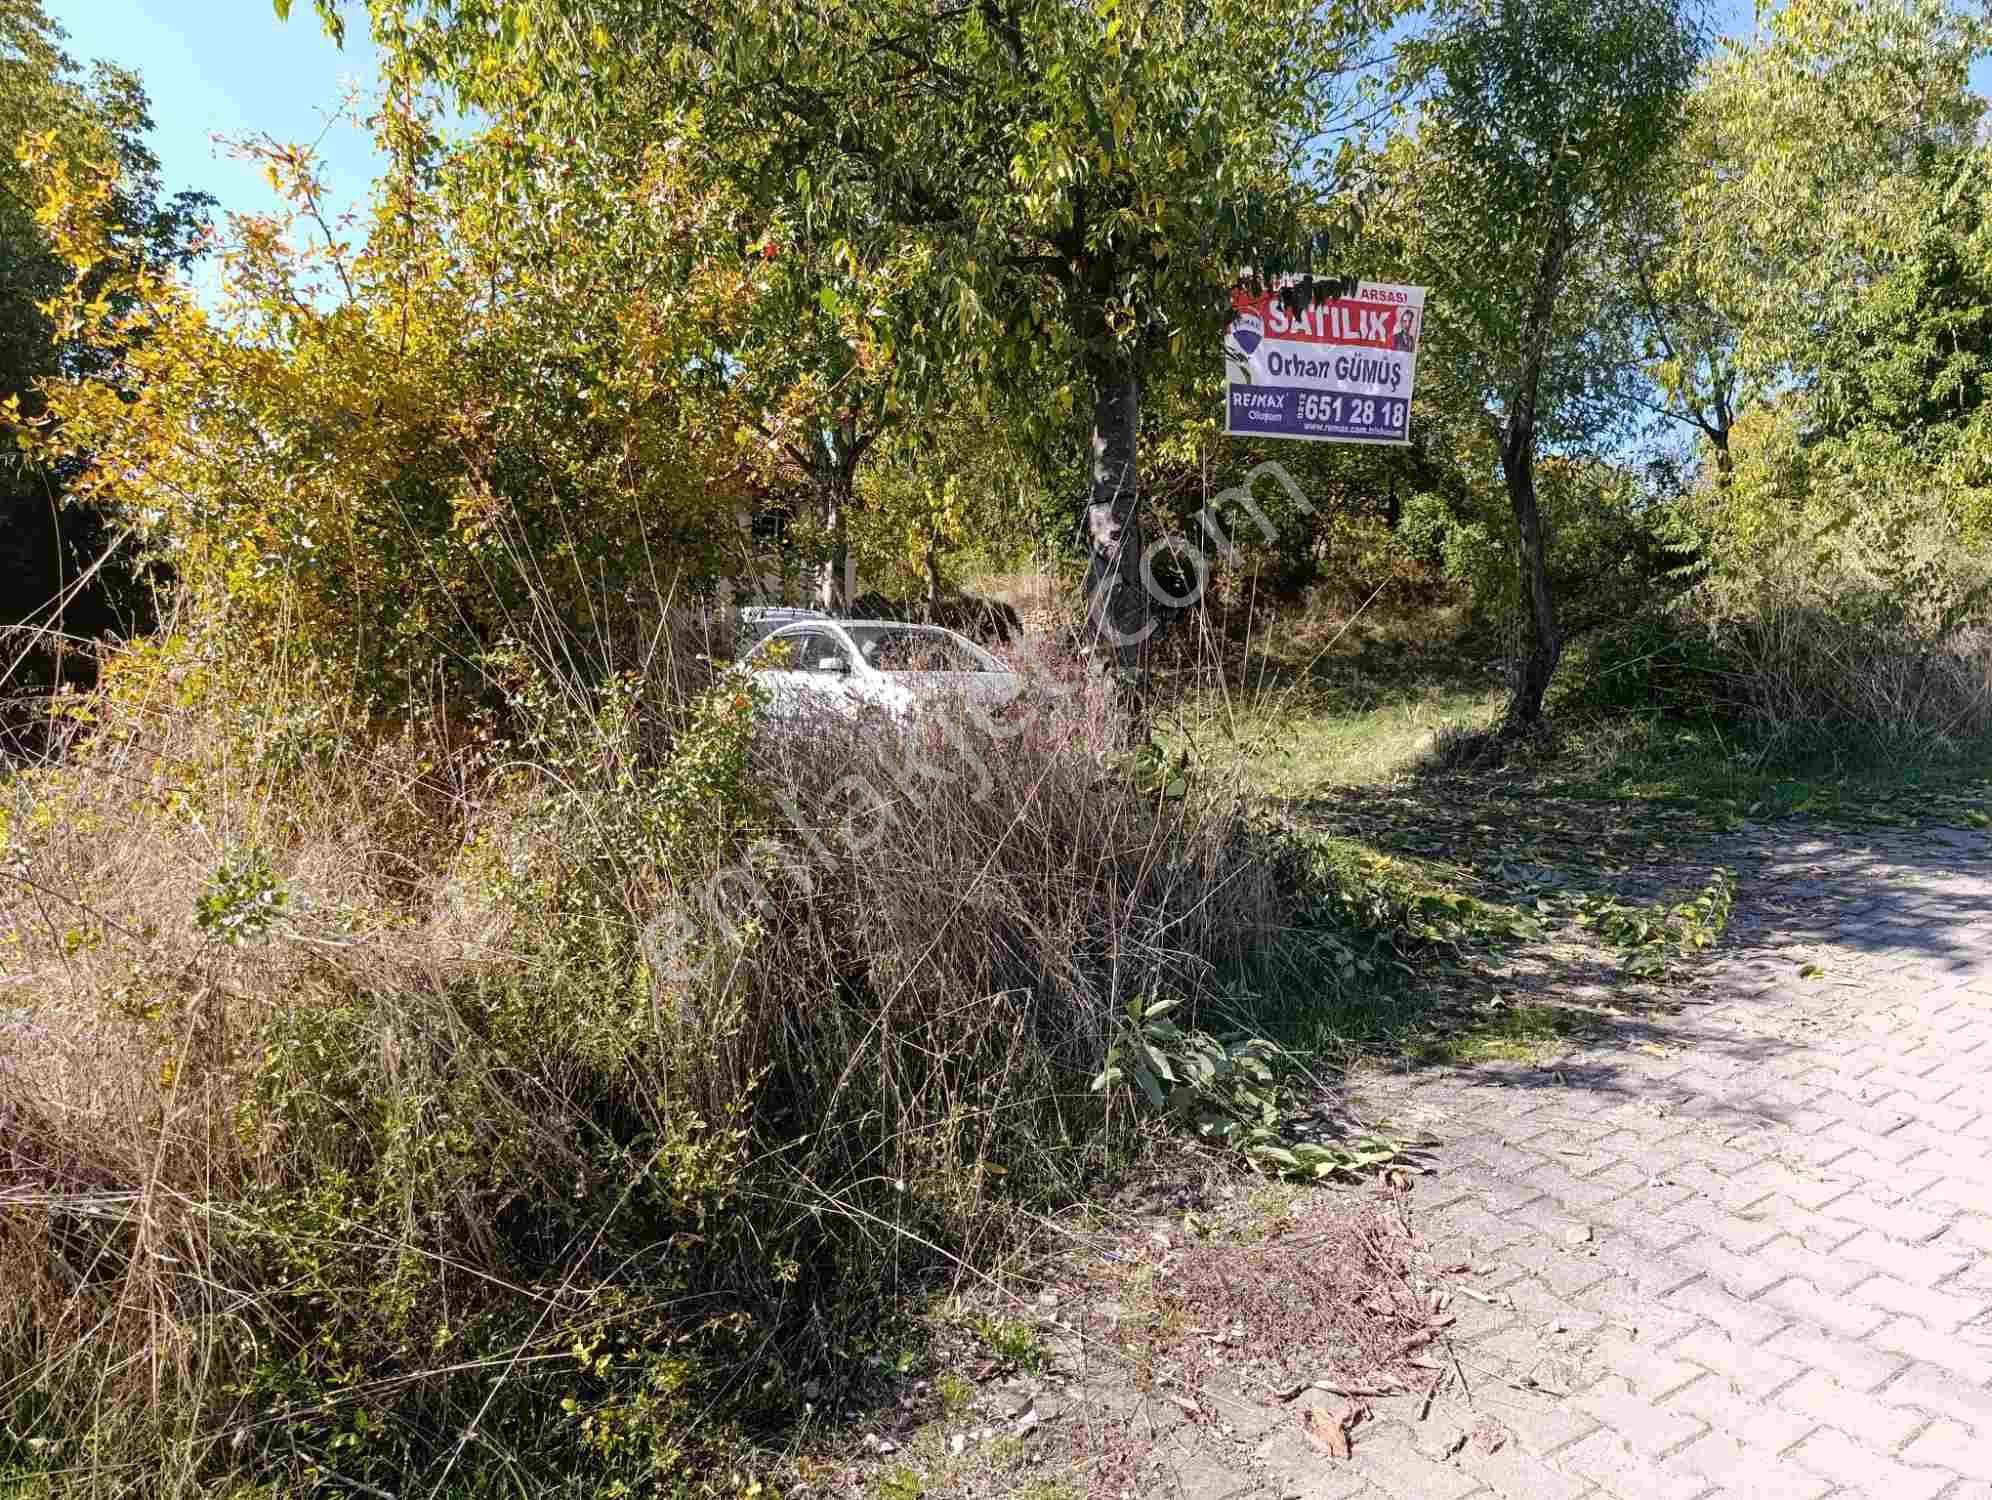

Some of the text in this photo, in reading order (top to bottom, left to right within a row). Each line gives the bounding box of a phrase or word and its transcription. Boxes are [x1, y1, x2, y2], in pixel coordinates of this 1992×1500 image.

[1361, 288, 1408, 304] ARSASI
[1268, 299, 1392, 344] SATILIK
[1267, 351, 1401, 392] Orhan GÜMÜŞ
[1233, 392, 1285, 409] RE/MAX
[1305, 394, 1344, 423] 651
[1349, 398, 1375, 425] 28
[1382, 401, 1405, 427] 18
